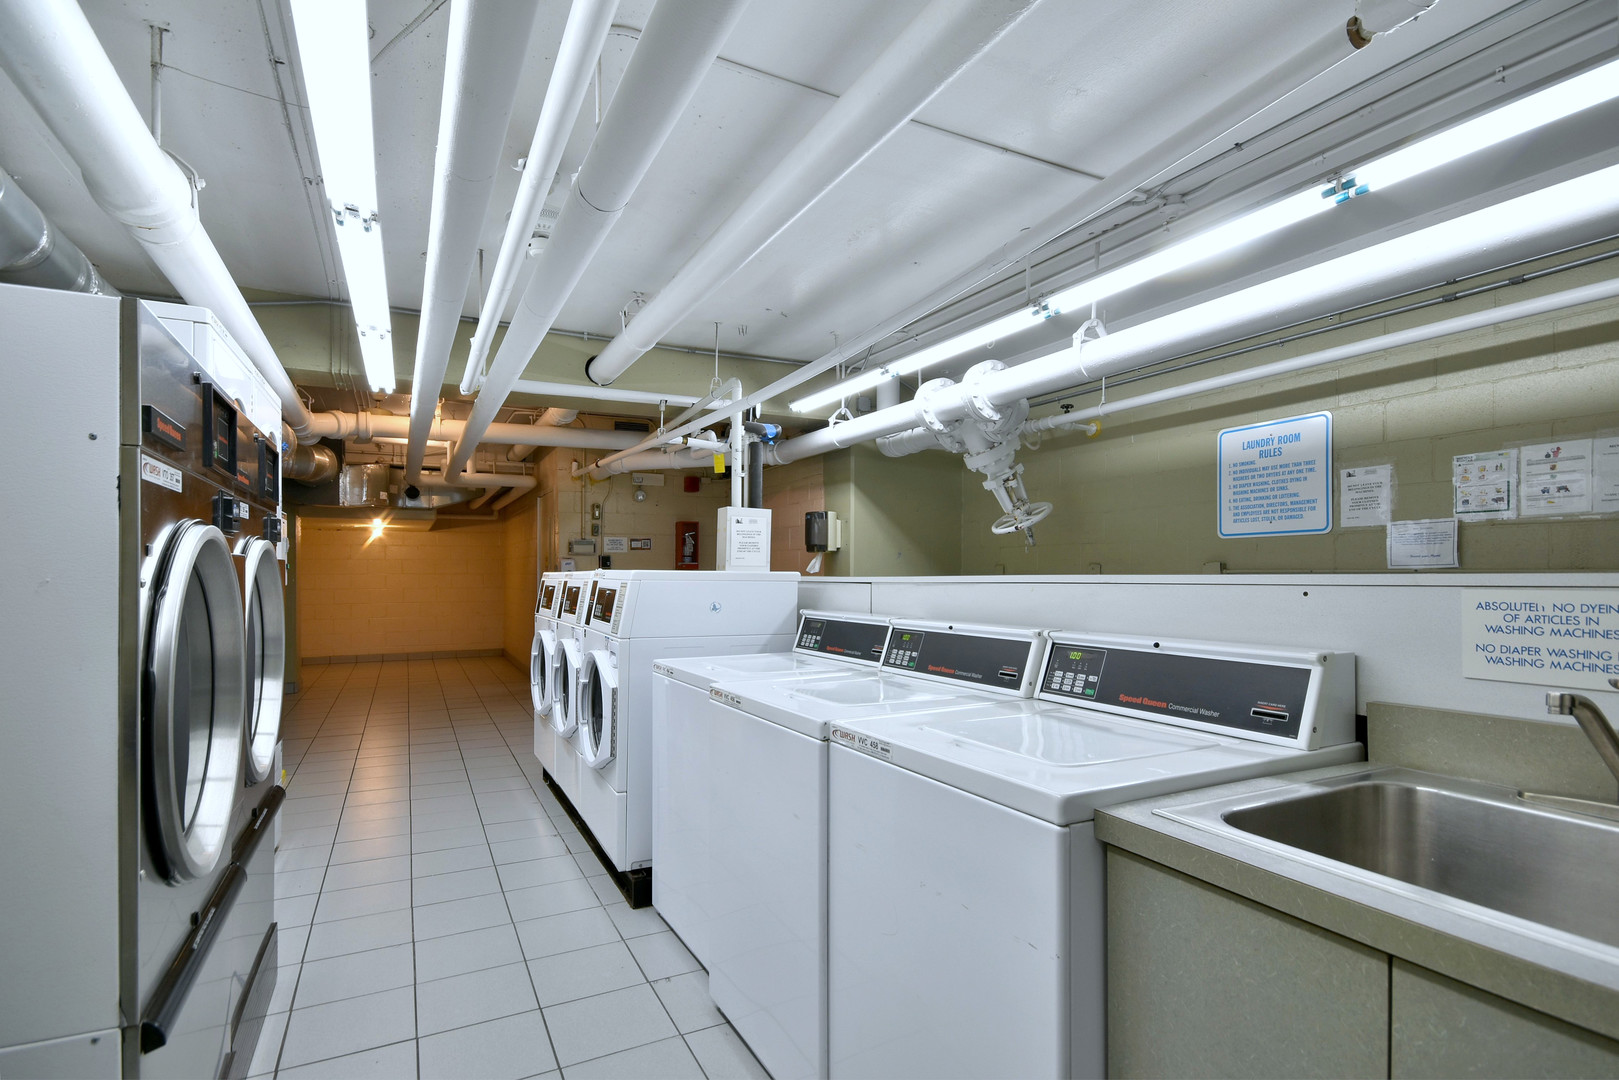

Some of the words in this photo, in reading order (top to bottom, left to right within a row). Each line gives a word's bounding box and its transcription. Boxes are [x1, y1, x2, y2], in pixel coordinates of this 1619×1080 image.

[1242, 436, 1275, 450] LAUNDRY
[1278, 432, 1300, 445] ROOM
[1258, 446, 1282, 458] RULES
[1239, 466, 1260, 474] INDIVIDUALS
[1552, 603, 1576, 613] NO
[1503, 614, 1520, 623] OF
[1524, 614, 1580, 626] ARTICLES
[1586, 616, 1600, 626] IN
[1484, 624, 1544, 636] WASHING
[1550, 628, 1619, 640] MACHINES
[1476, 644, 1496, 653] NO
[1500, 644, 1541, 656] DIAPER
[1546, 648, 1612, 661] WASHING
[1484, 655, 1544, 668] WASHING
[1550, 661, 1619, 674] MACHINES
[1118, 693, 1142, 704] Speed
[1142, 697, 1168, 708] Queen
[1168, 702, 1198, 714] Commercial
[1199, 708, 1220, 718] Washer
